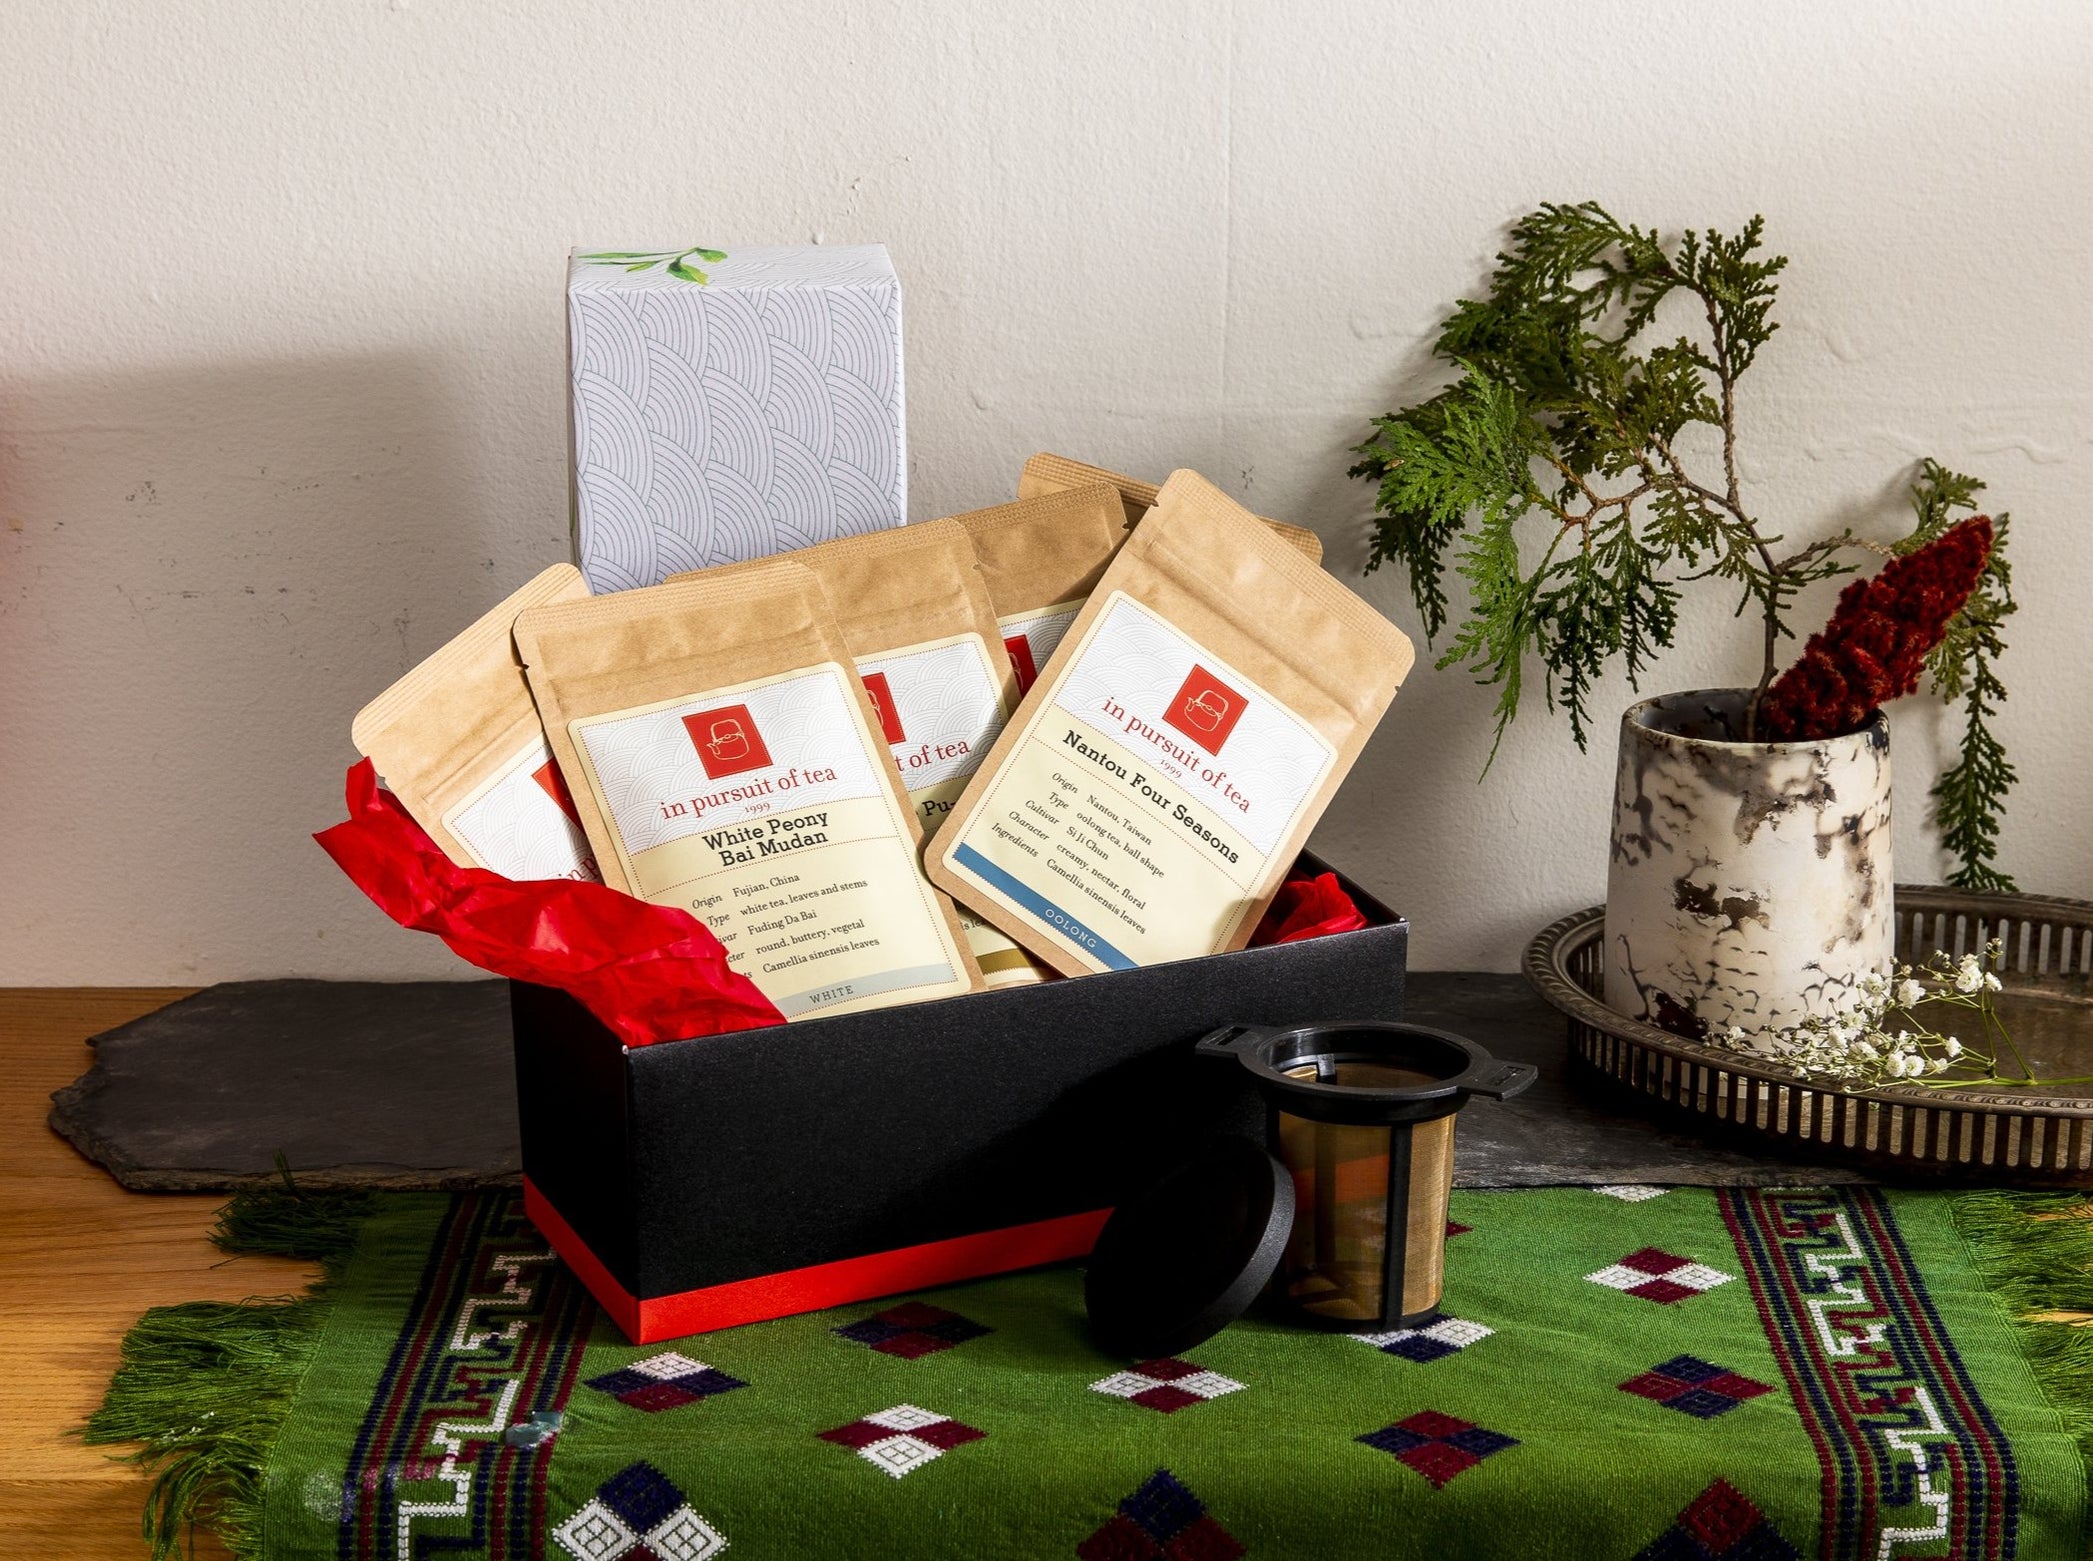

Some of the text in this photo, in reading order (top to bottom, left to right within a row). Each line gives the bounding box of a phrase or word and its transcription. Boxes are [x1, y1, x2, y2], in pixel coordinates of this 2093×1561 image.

[909, 745, 932, 768] of
[935, 741, 970, 760] tea
[1101, 696, 1250, 813] in pursuit of tea
[1161, 759, 1183, 779] 1999
[660, 768, 838, 820] in pursuit of tea
[745, 802, 770, 814] 1999
[1051, 772, 1079, 794] Origin
[1122, 818, 1152, 846] Taiwan
[1063, 730, 1239, 864] Nantou Four Seasons
[702, 812, 828, 851] White Peony
[719, 832, 828, 867] Bai Mudan
[1025, 800, 1109, 861] Cultivar Si Ji Chun
[1049, 792, 1070, 810] Type
[1076, 812, 1107, 837] oolong
[1123, 842, 1142, 860] ball
[1140, 856, 1165, 879] shape
[991, 822, 1147, 935] Ingredients Camellia sinensis leaves
[1008, 810, 1050, 841] Character
[1121, 888, 1147, 911] floral
[692, 894, 722, 910] Origin
[769, 873, 800, 888] China
[707, 913, 730, 928] Type
[740, 902, 768, 916] white
[790, 889, 819, 903] leaves
[821, 884, 839, 897] and
[840, 879, 868, 892] stems
[717, 910, 817, 944] ivar Fuding Da Bai
[831, 919, 865, 935] vegetal
[1045, 908, 1097, 948] OOLONG
[763, 955, 808, 974] Camellia
[809, 944, 850, 961] sinensis
[850, 936, 880, 951] leaves
[809, 985, 854, 1004] WHITE
